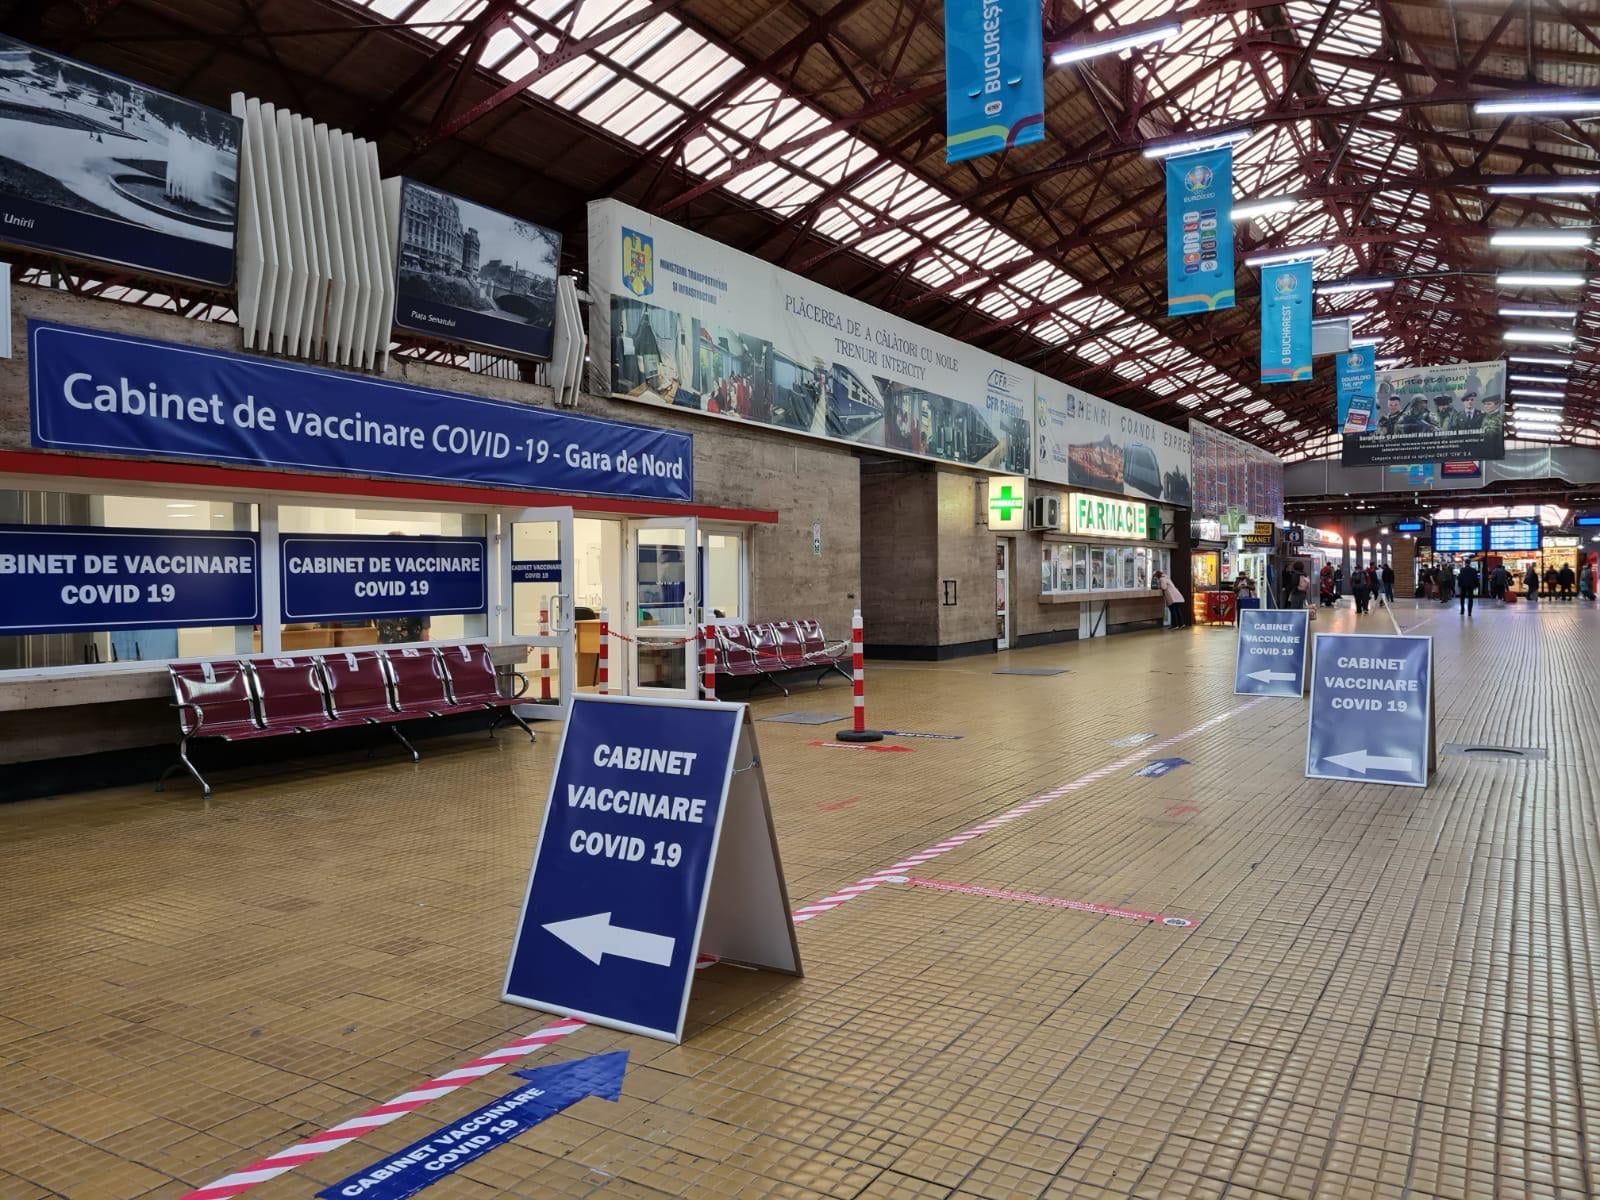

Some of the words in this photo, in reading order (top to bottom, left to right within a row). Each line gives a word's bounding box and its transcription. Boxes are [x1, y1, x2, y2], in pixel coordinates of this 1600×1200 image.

[4, 213, 35, 229] Unirii
[1281, 304, 1292, 356] BUCHAREST
[847, 319, 861, 337] DE
[865, 327, 872, 342] A
[920, 346, 933, 363] CU
[935, 352, 959, 372] NOILE
[834, 337, 878, 366] TRENURI
[882, 353, 926, 381] INTERCITY
[994, 373, 1008, 388] CFR
[1078, 400, 1112, 428] HENRI
[63, 372, 225, 425] Cabinet
[233, 395, 276, 431] de
[284, 409, 425, 450] vaccinare
[432, 424, 510, 459] COVID
[616, 449, 638, 475] de
[642, 453, 683, 480] Nord
[1078, 499, 1145, 534] FARMACIE
[84, 555, 118, 574] DE
[124, 555, 252, 574] VACCINARE
[289, 557, 365, 574] CABINET
[369, 557, 391, 573] DE
[395, 557, 480, 573] VACCINARE
[61, 584, 140, 605] COVID
[147, 583, 176, 603] 19
[354, 580, 406, 597] COVID
[410, 580, 430, 596] 19
[1254, 623, 1295, 631] CABINET
[1246, 635, 1300, 644] VACCINARE
[1250, 647, 1280, 656] COVID
[1281, 648, 1294, 656] 19
[1337, 657, 1407, 671] CABINET
[1324, 676, 1418, 692] VACCINARE
[1331, 698, 1383, 711] COVID
[1387, 700, 1408, 713] 19
[593, 744, 697, 776] CABINET
[567, 784, 706, 823] VACCINARE
[569, 830, 645, 862] COVID
[650, 841, 682, 868] 19
[341, 1143, 432, 1198] CABINET
[436, 1087, 546, 1145] VACCINARE
[424, 1134, 492, 1172] COVID
[489, 1118, 519, 1137] 19
